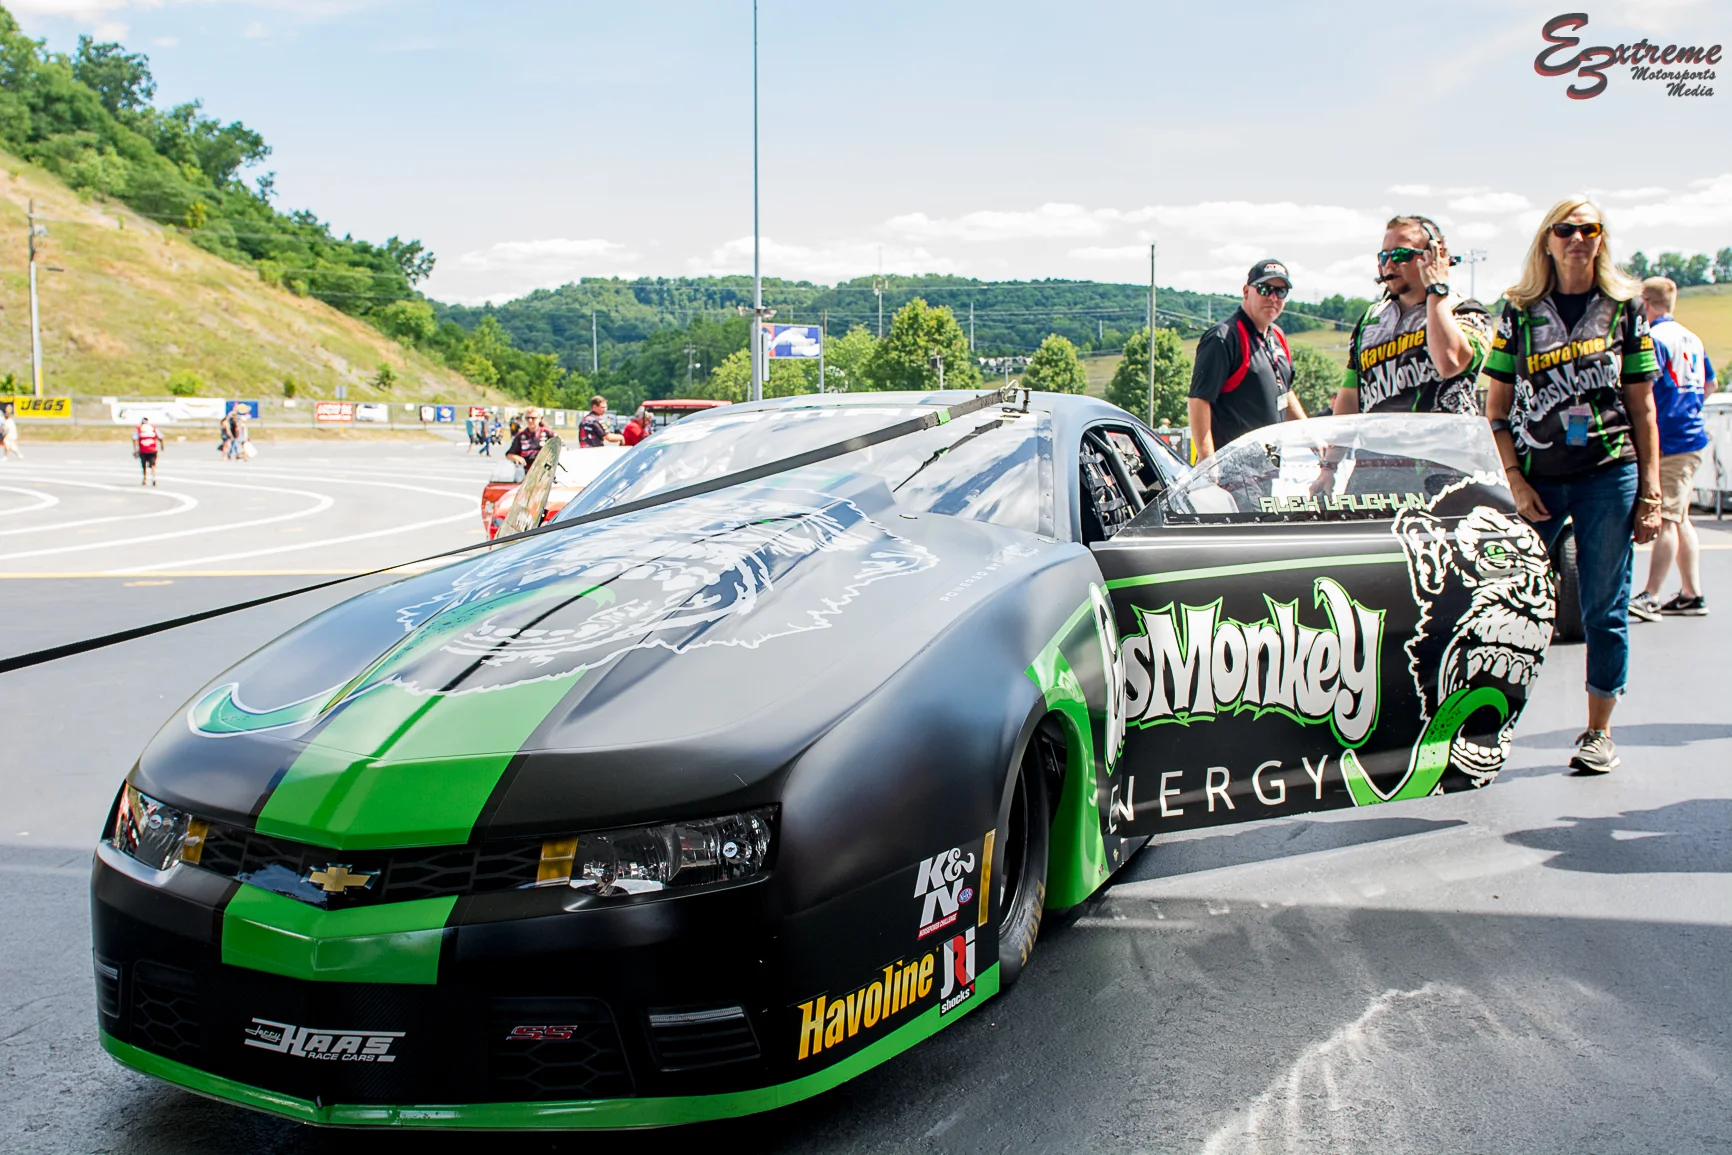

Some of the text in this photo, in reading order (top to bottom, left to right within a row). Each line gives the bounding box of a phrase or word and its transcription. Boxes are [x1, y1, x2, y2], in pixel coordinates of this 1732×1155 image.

[1526, 337, 1606, 374] Havoline
[21, 399, 65, 411] JEGS
[1259, 492, 1430, 515] ALEX LAUGHLIN
[797, 952, 935, 1061] Havoline
[941, 988, 971, 1014] shocks
[270, 1023, 405, 1057] HAAS
[506, 1025, 578, 1041] SS
[307, 1052, 375, 1062] RACE CARS
